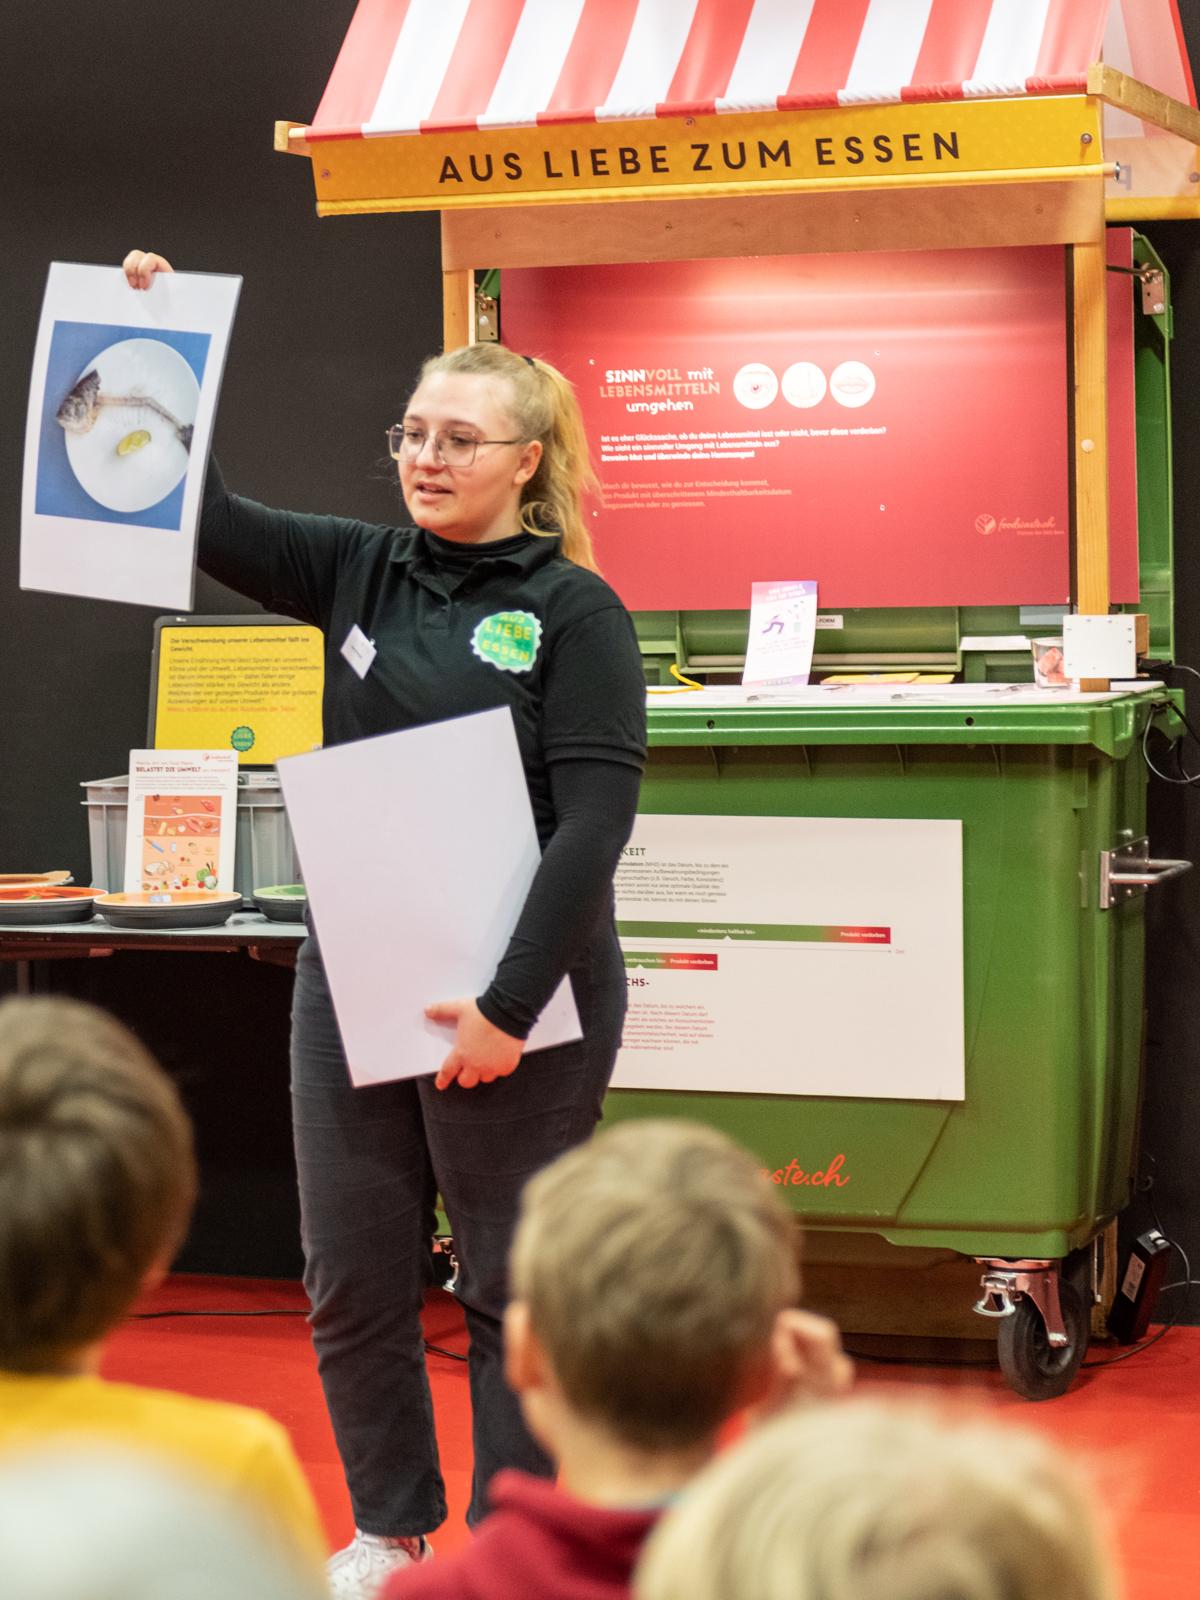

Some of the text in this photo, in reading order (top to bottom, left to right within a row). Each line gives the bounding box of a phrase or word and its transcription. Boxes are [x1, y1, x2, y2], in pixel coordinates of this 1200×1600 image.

[438, 131, 960, 184] AUS LIEBE ZUM ESSEN
[605, 367, 714, 383] SINNVOLL mit
[600, 382, 720, 398] LEBENSMITTELN
[626, 399, 694, 415] umgehen
[484, 620, 533, 640] LIEBE
[621, 847, 646, 856] KEIT
[625, 977, 650, 987] CHS-
[766, 1154, 851, 1187] ste.ch
